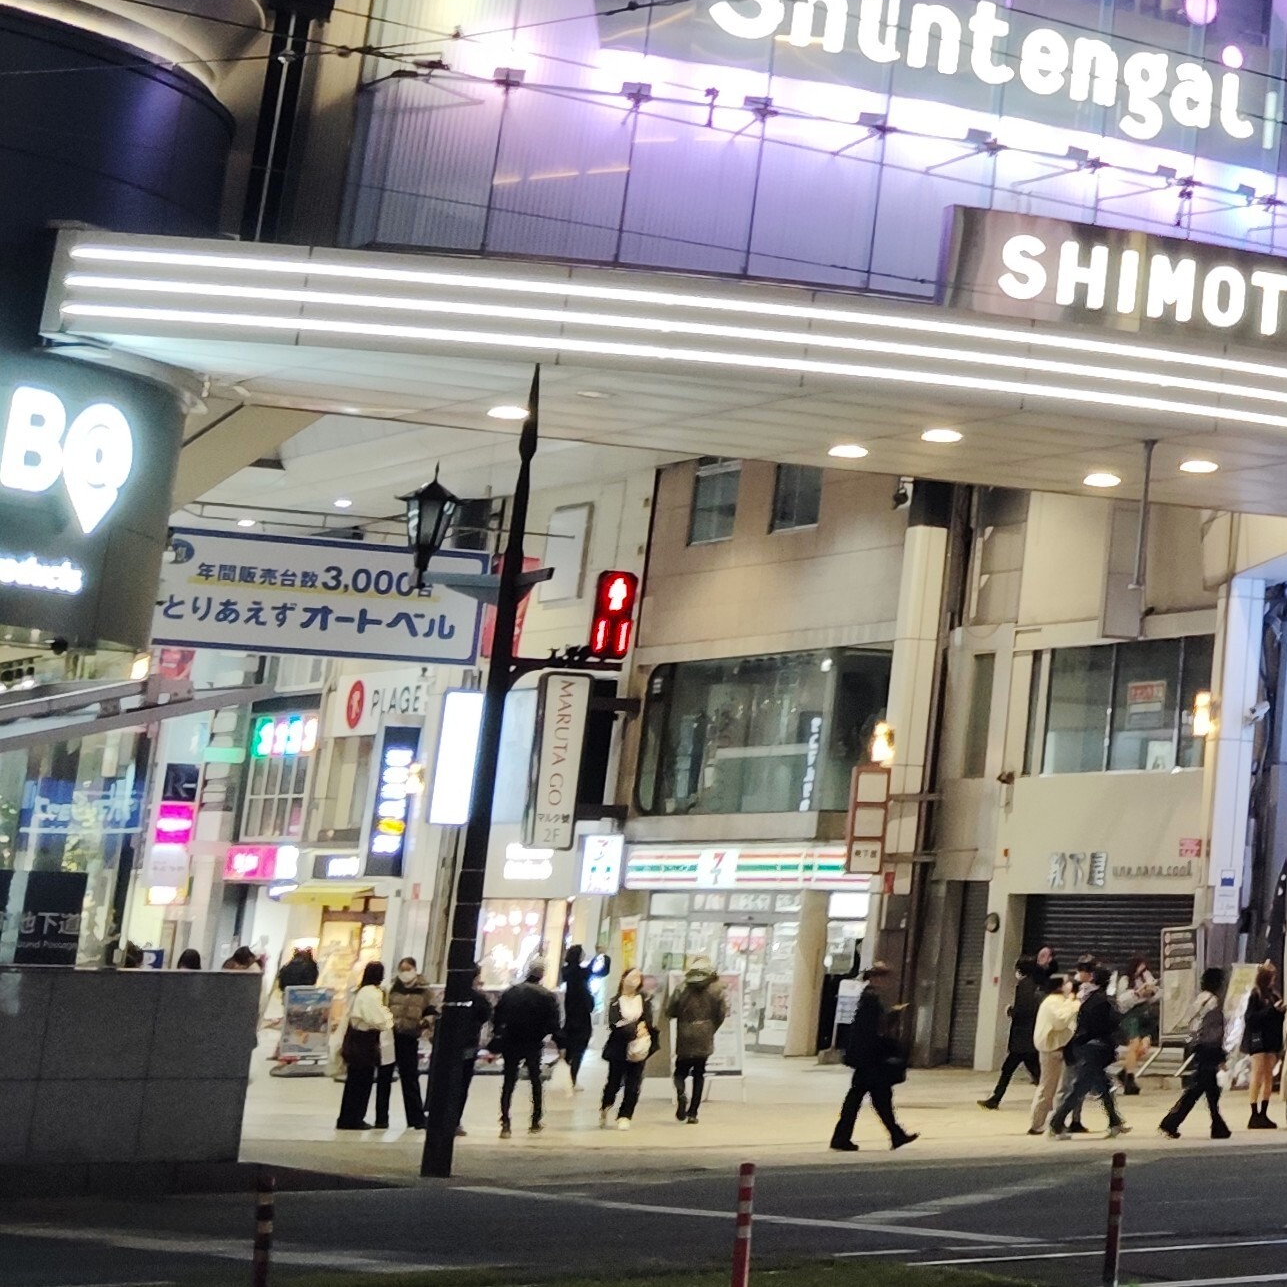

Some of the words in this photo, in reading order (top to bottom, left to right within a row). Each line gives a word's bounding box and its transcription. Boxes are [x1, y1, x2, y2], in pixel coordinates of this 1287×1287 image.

[371, 684, 422, 714] PLAGE
[551, 679, 576, 766] MARUTA
[547, 772, 565, 806] GO
[543, 827, 561, 843] 2F
